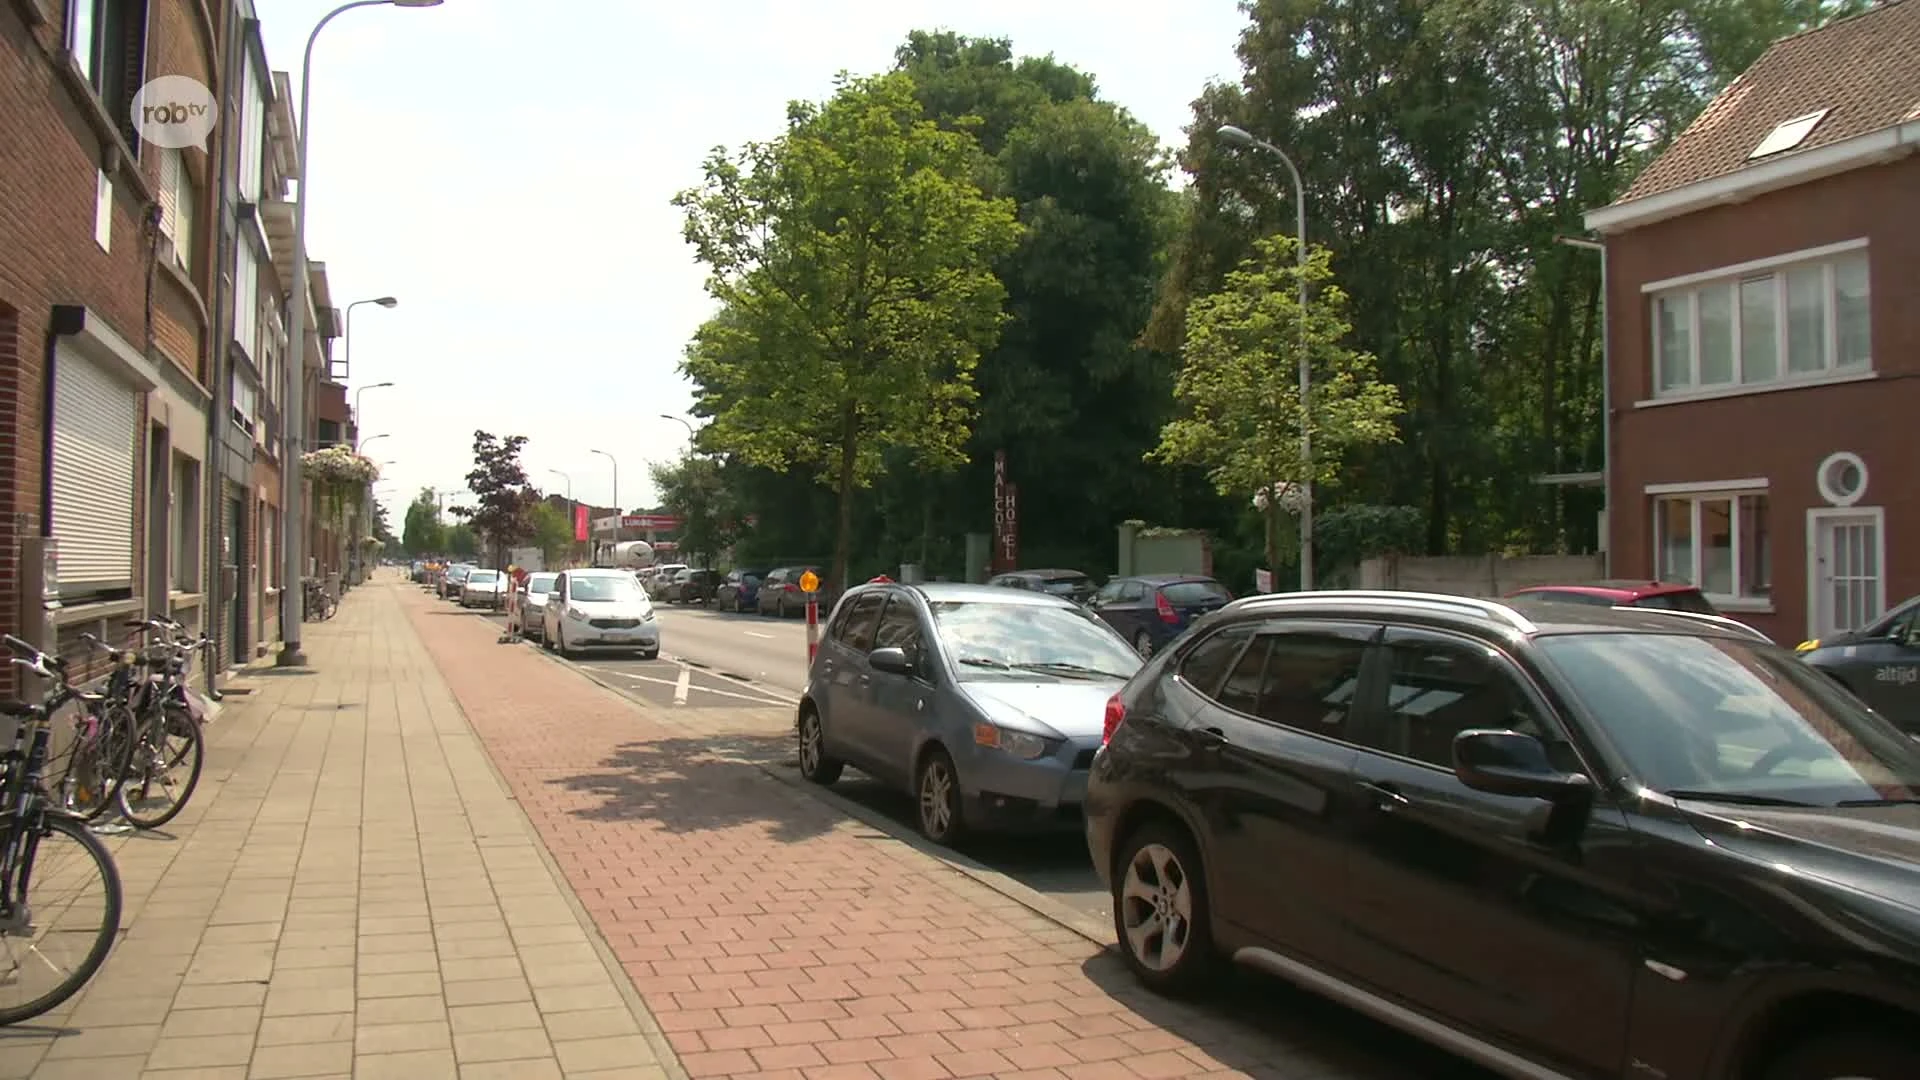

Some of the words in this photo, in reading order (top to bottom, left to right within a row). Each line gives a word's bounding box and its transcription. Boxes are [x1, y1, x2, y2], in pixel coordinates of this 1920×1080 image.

[994, 461, 1004, 537] MALCOT
[1006, 495, 1016, 561] HOTEL
[1875, 666, 1917, 684] altijd
